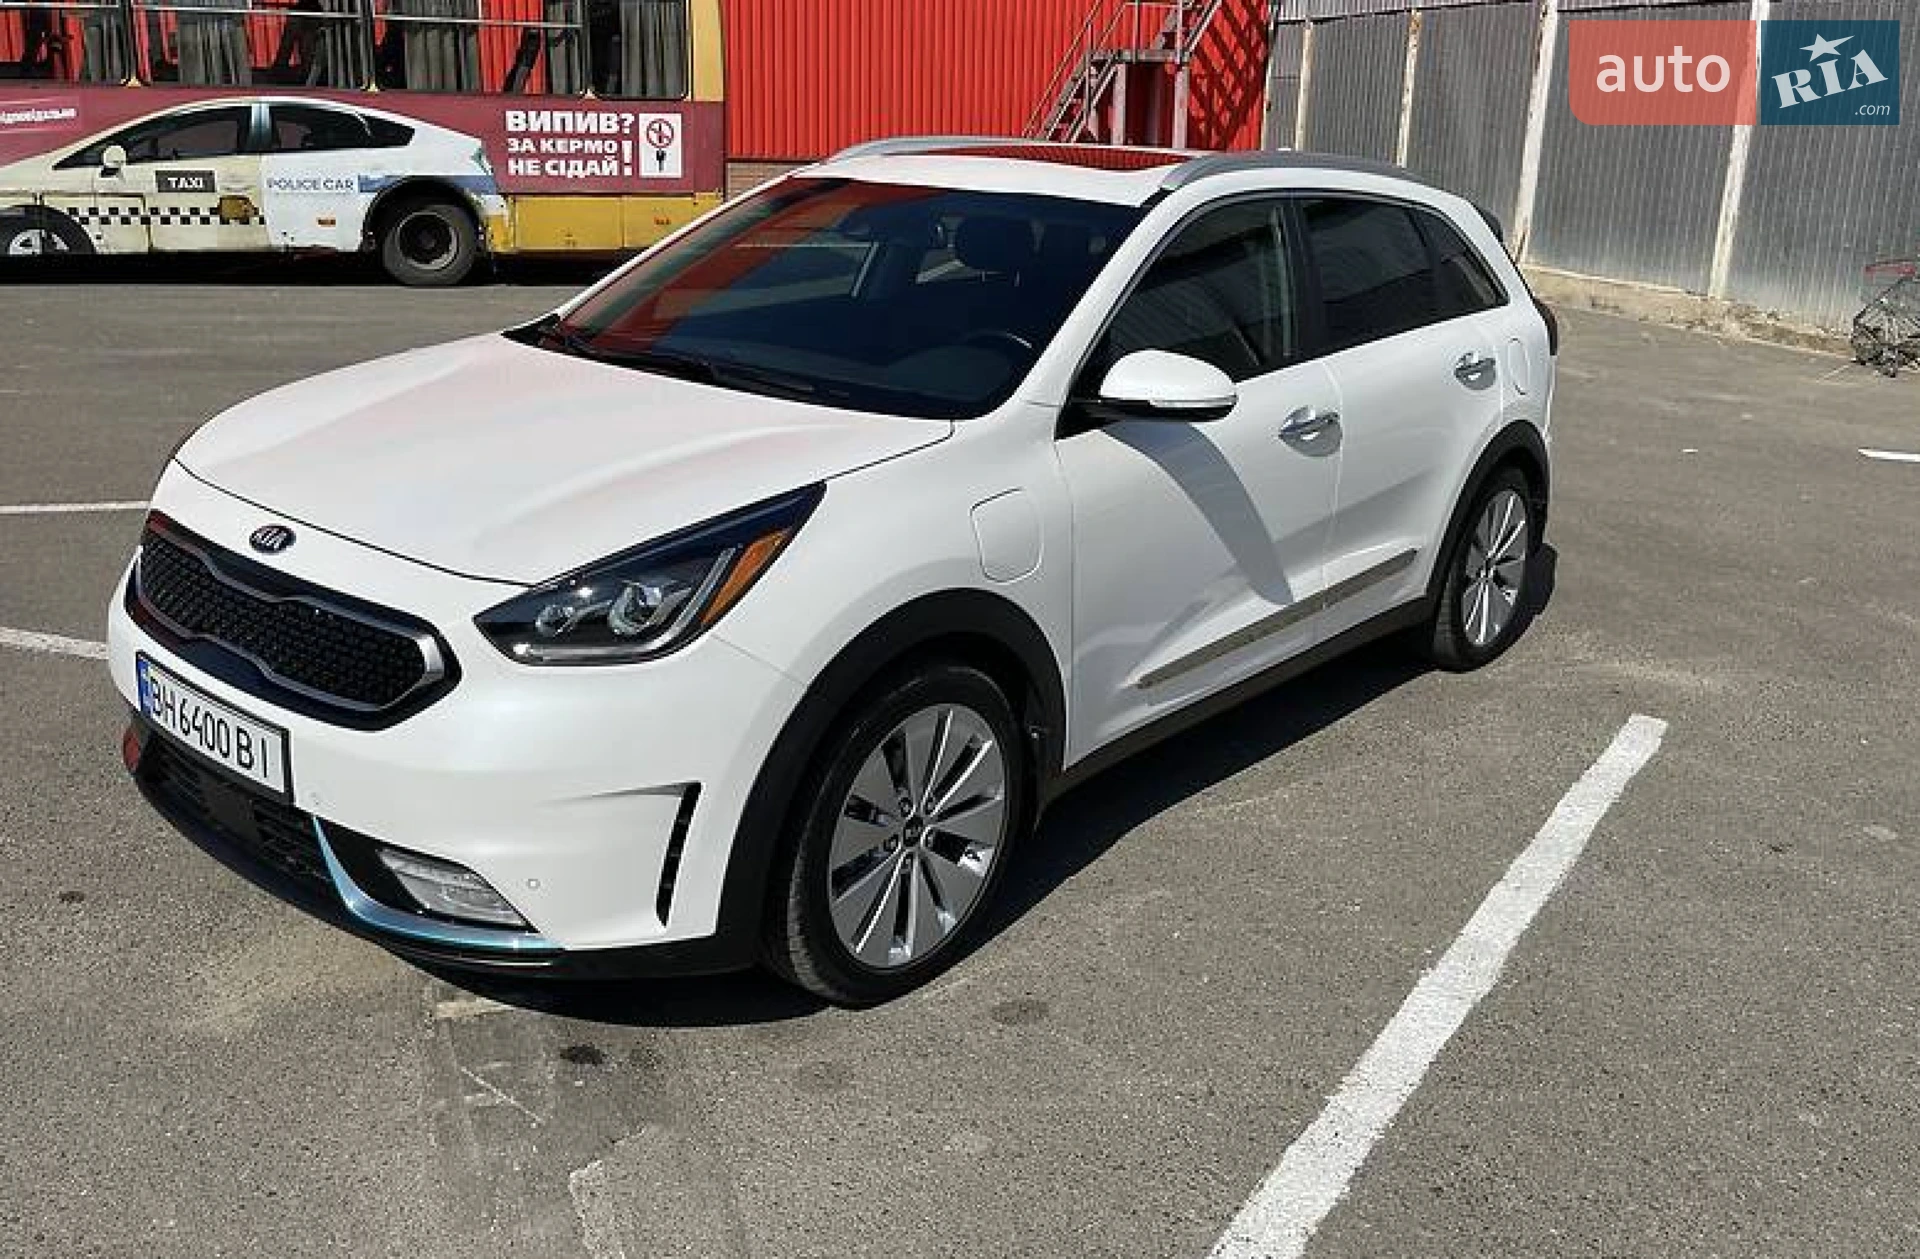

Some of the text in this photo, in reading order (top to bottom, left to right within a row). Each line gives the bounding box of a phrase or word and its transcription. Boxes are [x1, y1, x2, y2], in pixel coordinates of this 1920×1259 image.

[505, 110, 635, 134] ВИПИВ?
[507, 137, 618, 154] ЗА КЕРМО
[508, 159, 541, 176] НЕ
[167, 177, 204, 189] TAXI
[266, 177, 354, 190] POLICE CAR
[179, 697, 230, 758] 6400
